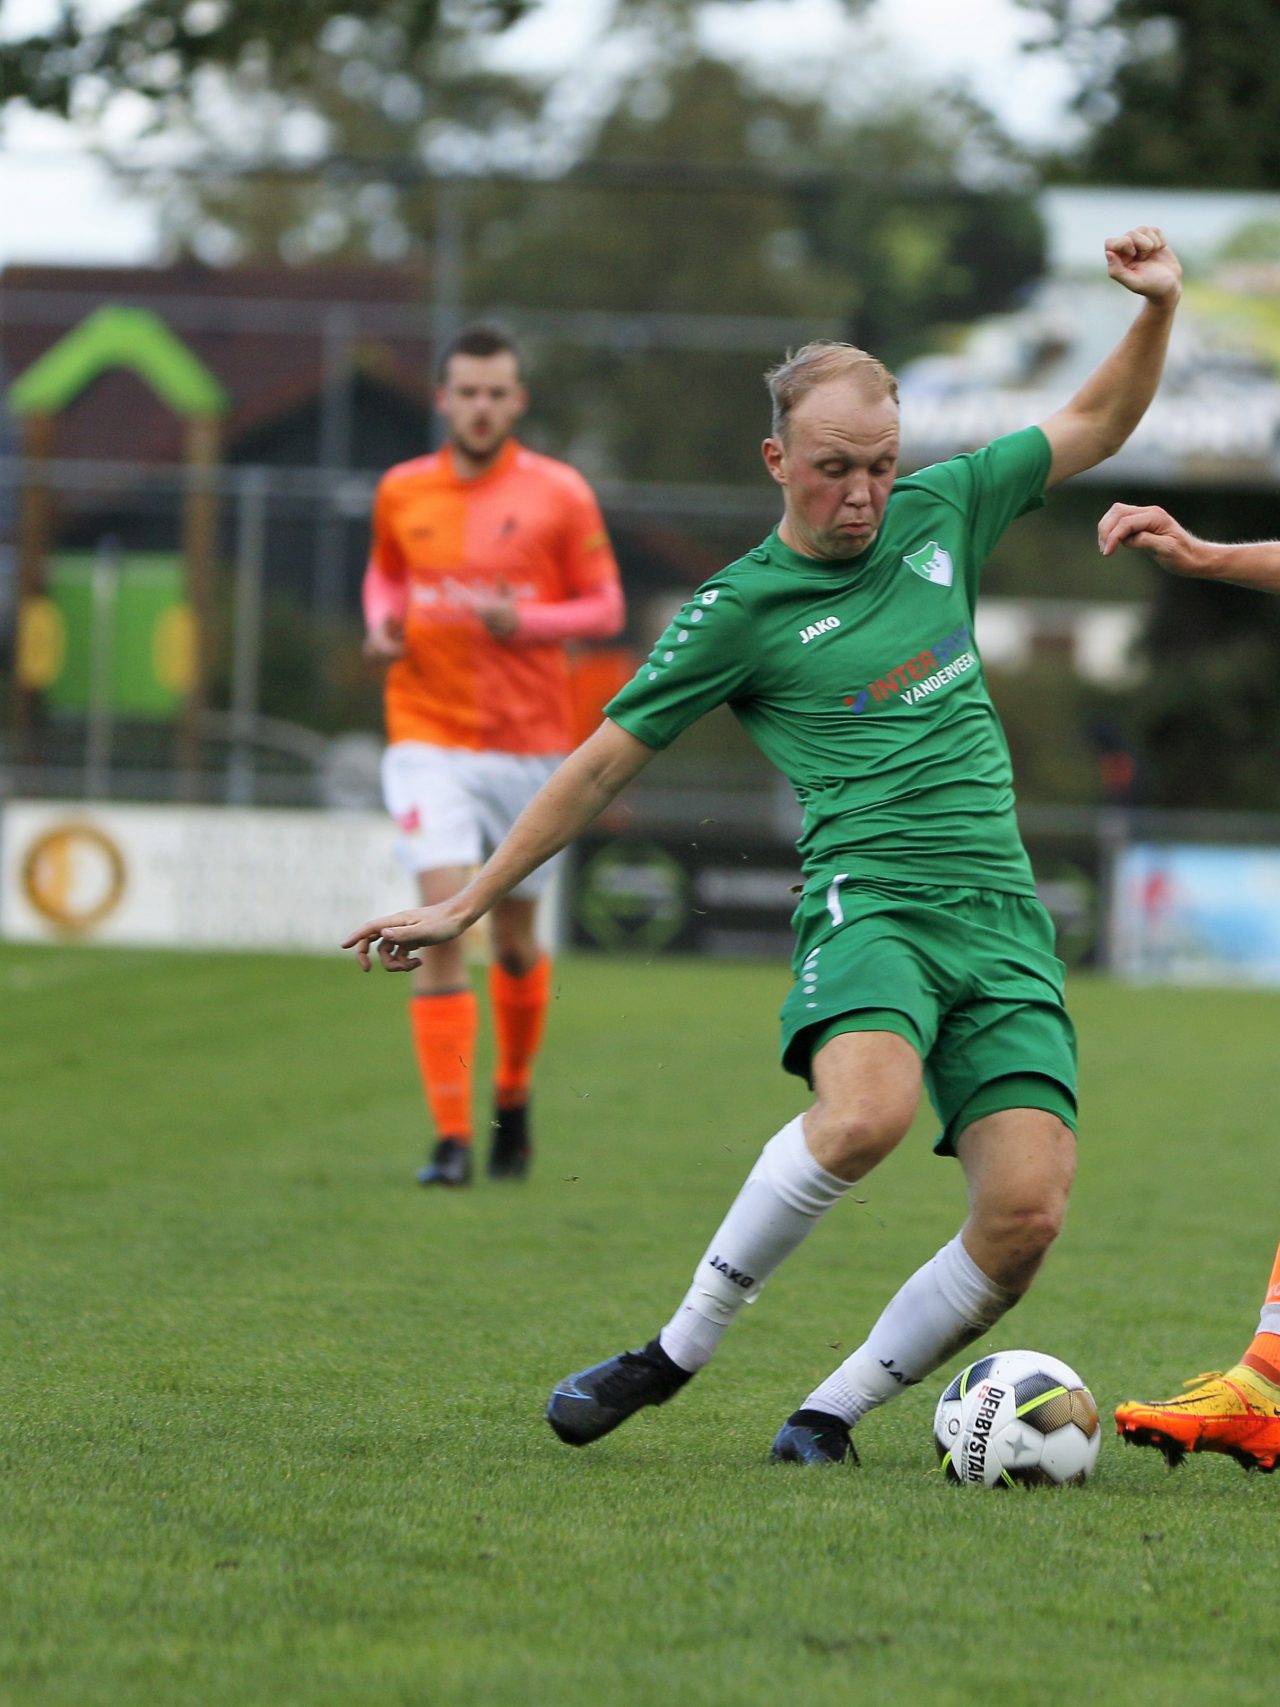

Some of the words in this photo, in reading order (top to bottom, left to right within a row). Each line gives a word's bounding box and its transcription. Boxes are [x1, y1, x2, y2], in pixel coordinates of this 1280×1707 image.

[798, 616, 841, 645] JAKO
[900, 651, 976, 705] VANDERVEEN
[709, 1255, 755, 1288] JAKO
[968, 1387, 1006, 1484] DERBYSTAR
